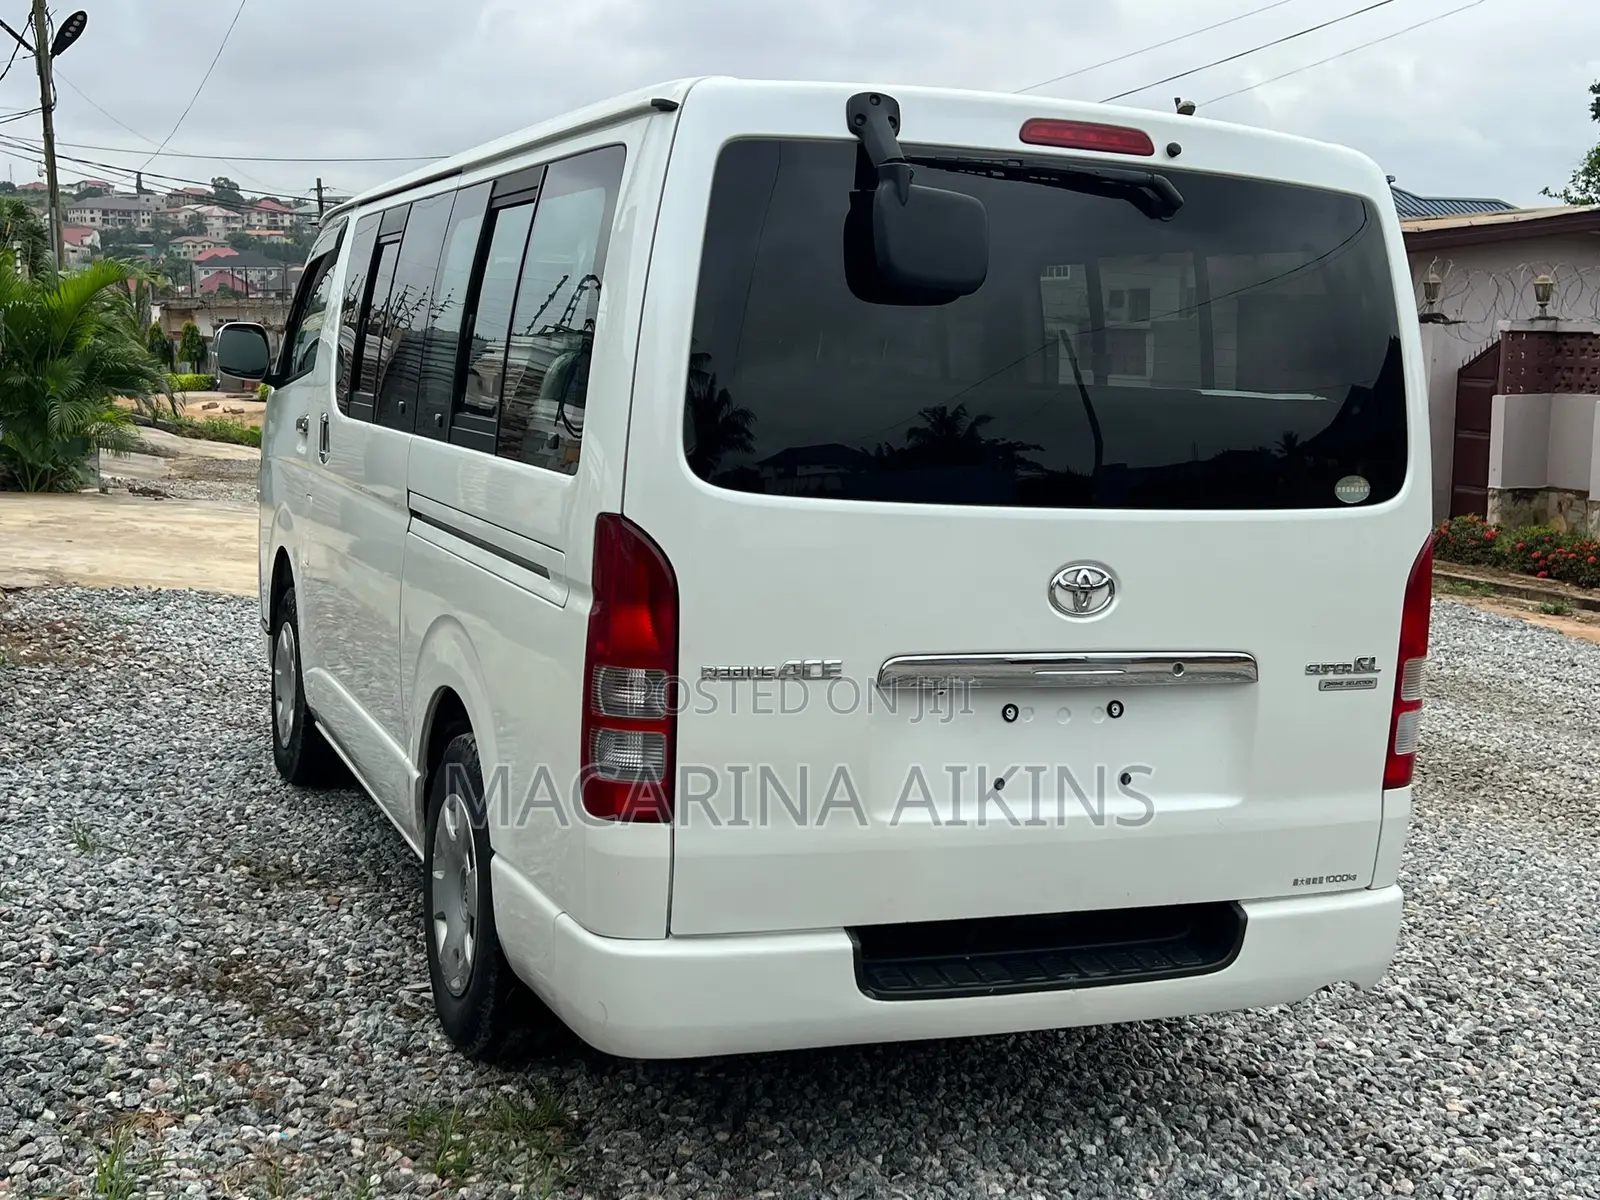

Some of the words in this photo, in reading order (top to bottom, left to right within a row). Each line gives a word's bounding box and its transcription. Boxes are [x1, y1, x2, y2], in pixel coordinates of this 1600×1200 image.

[779, 659, 842, 680] ACE
[1305, 662, 1352, 675] SUPER
[1353, 655, 1381, 673] GL
[1325, 873, 1357, 883] 1000kg
